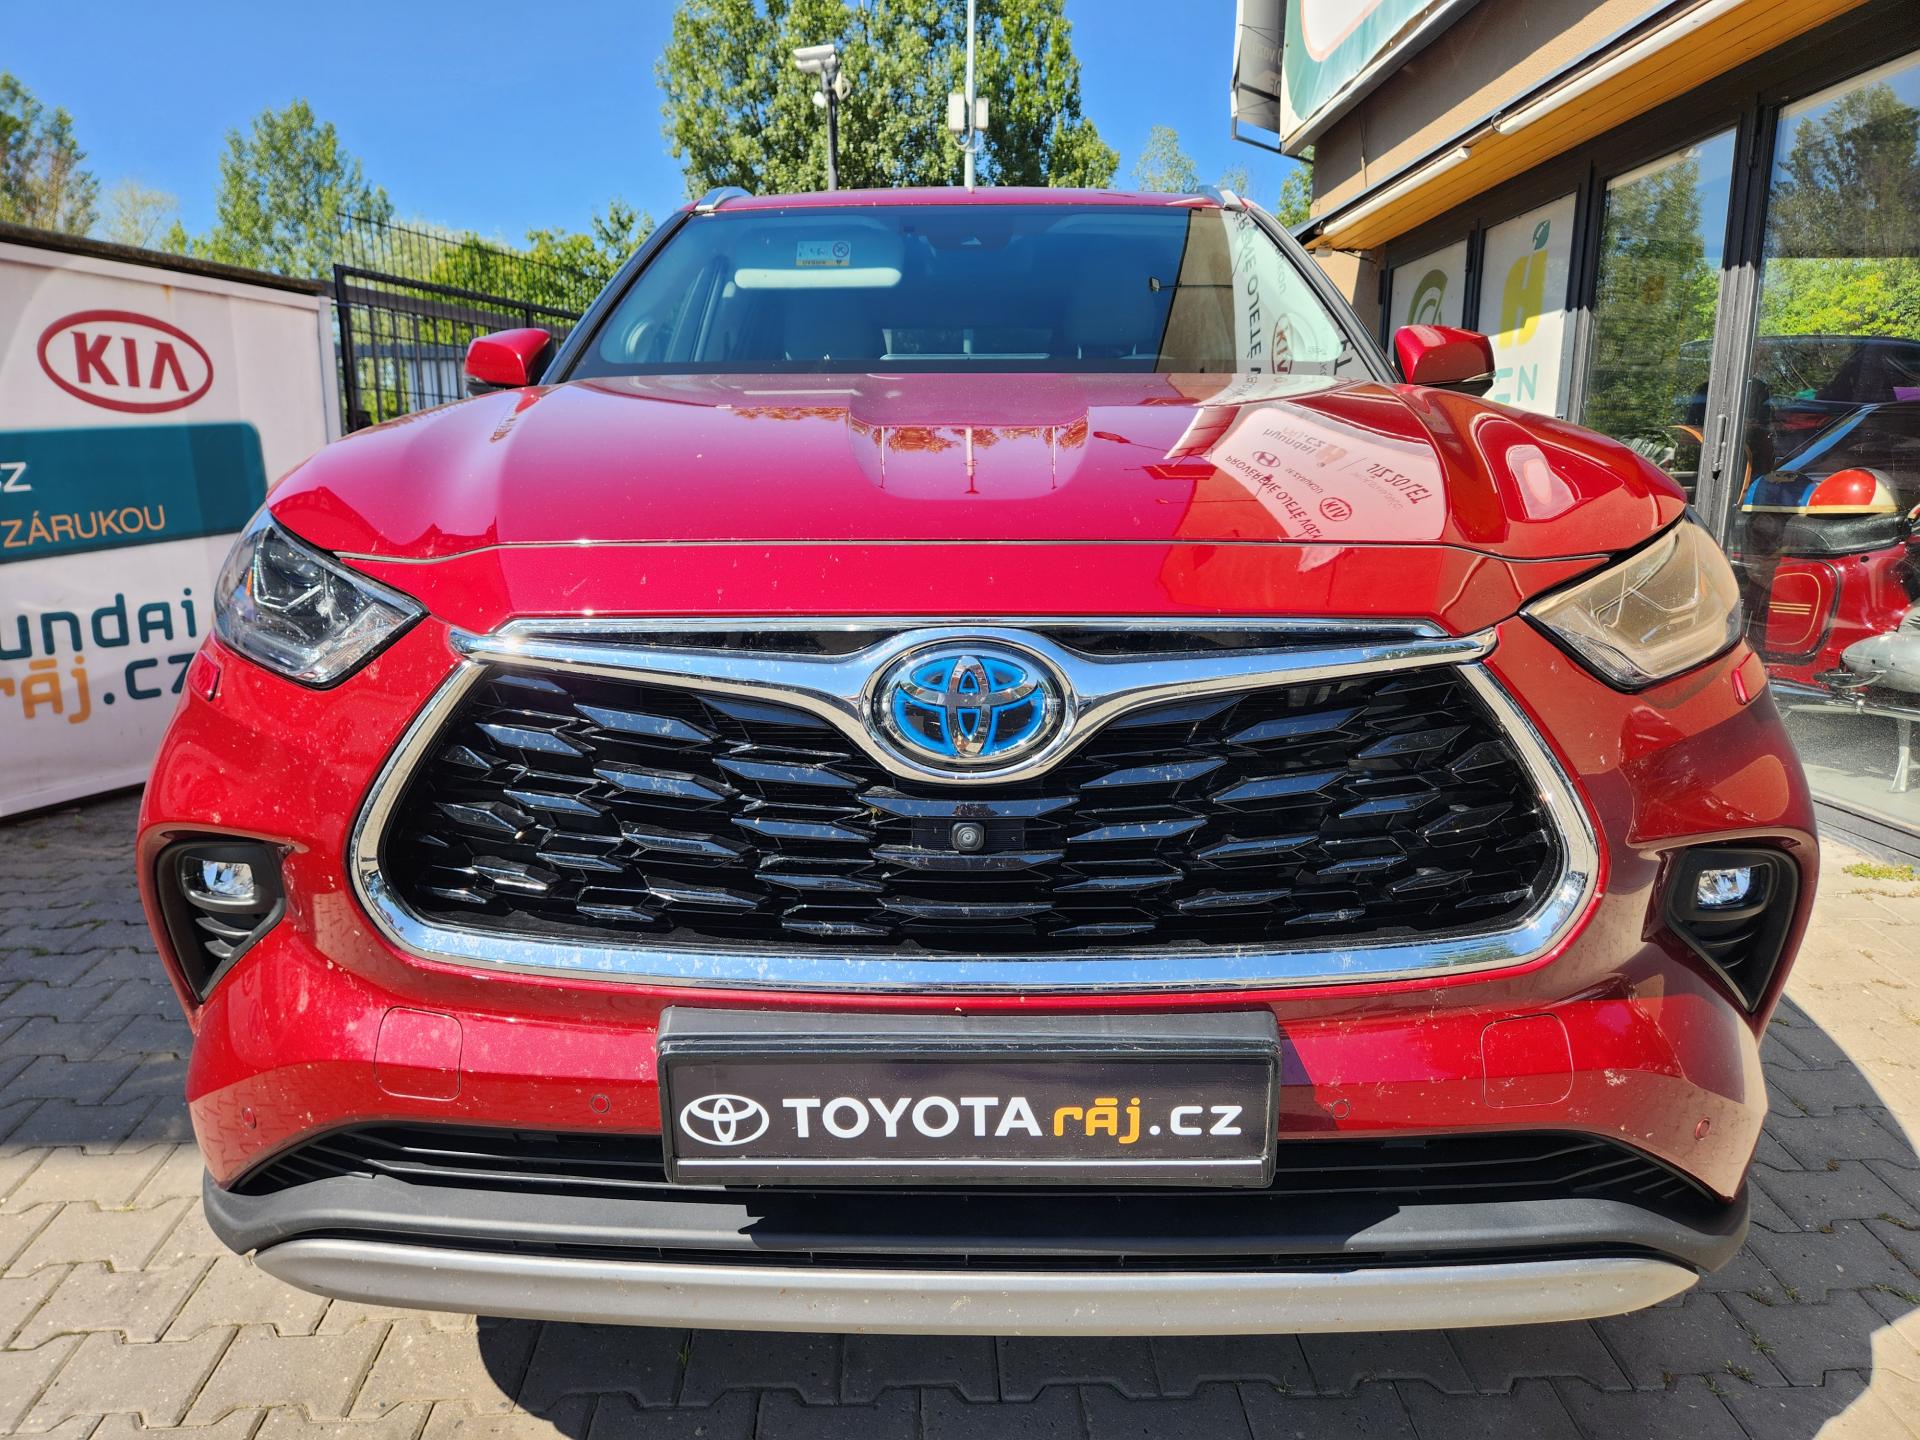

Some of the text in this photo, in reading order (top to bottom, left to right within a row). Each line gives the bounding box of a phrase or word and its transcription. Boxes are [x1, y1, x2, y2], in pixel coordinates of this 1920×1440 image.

[71, 330, 190, 392] KIA
[0, 461, 32, 493] Z
[1, 505, 165, 548] ZÁRUKOU
